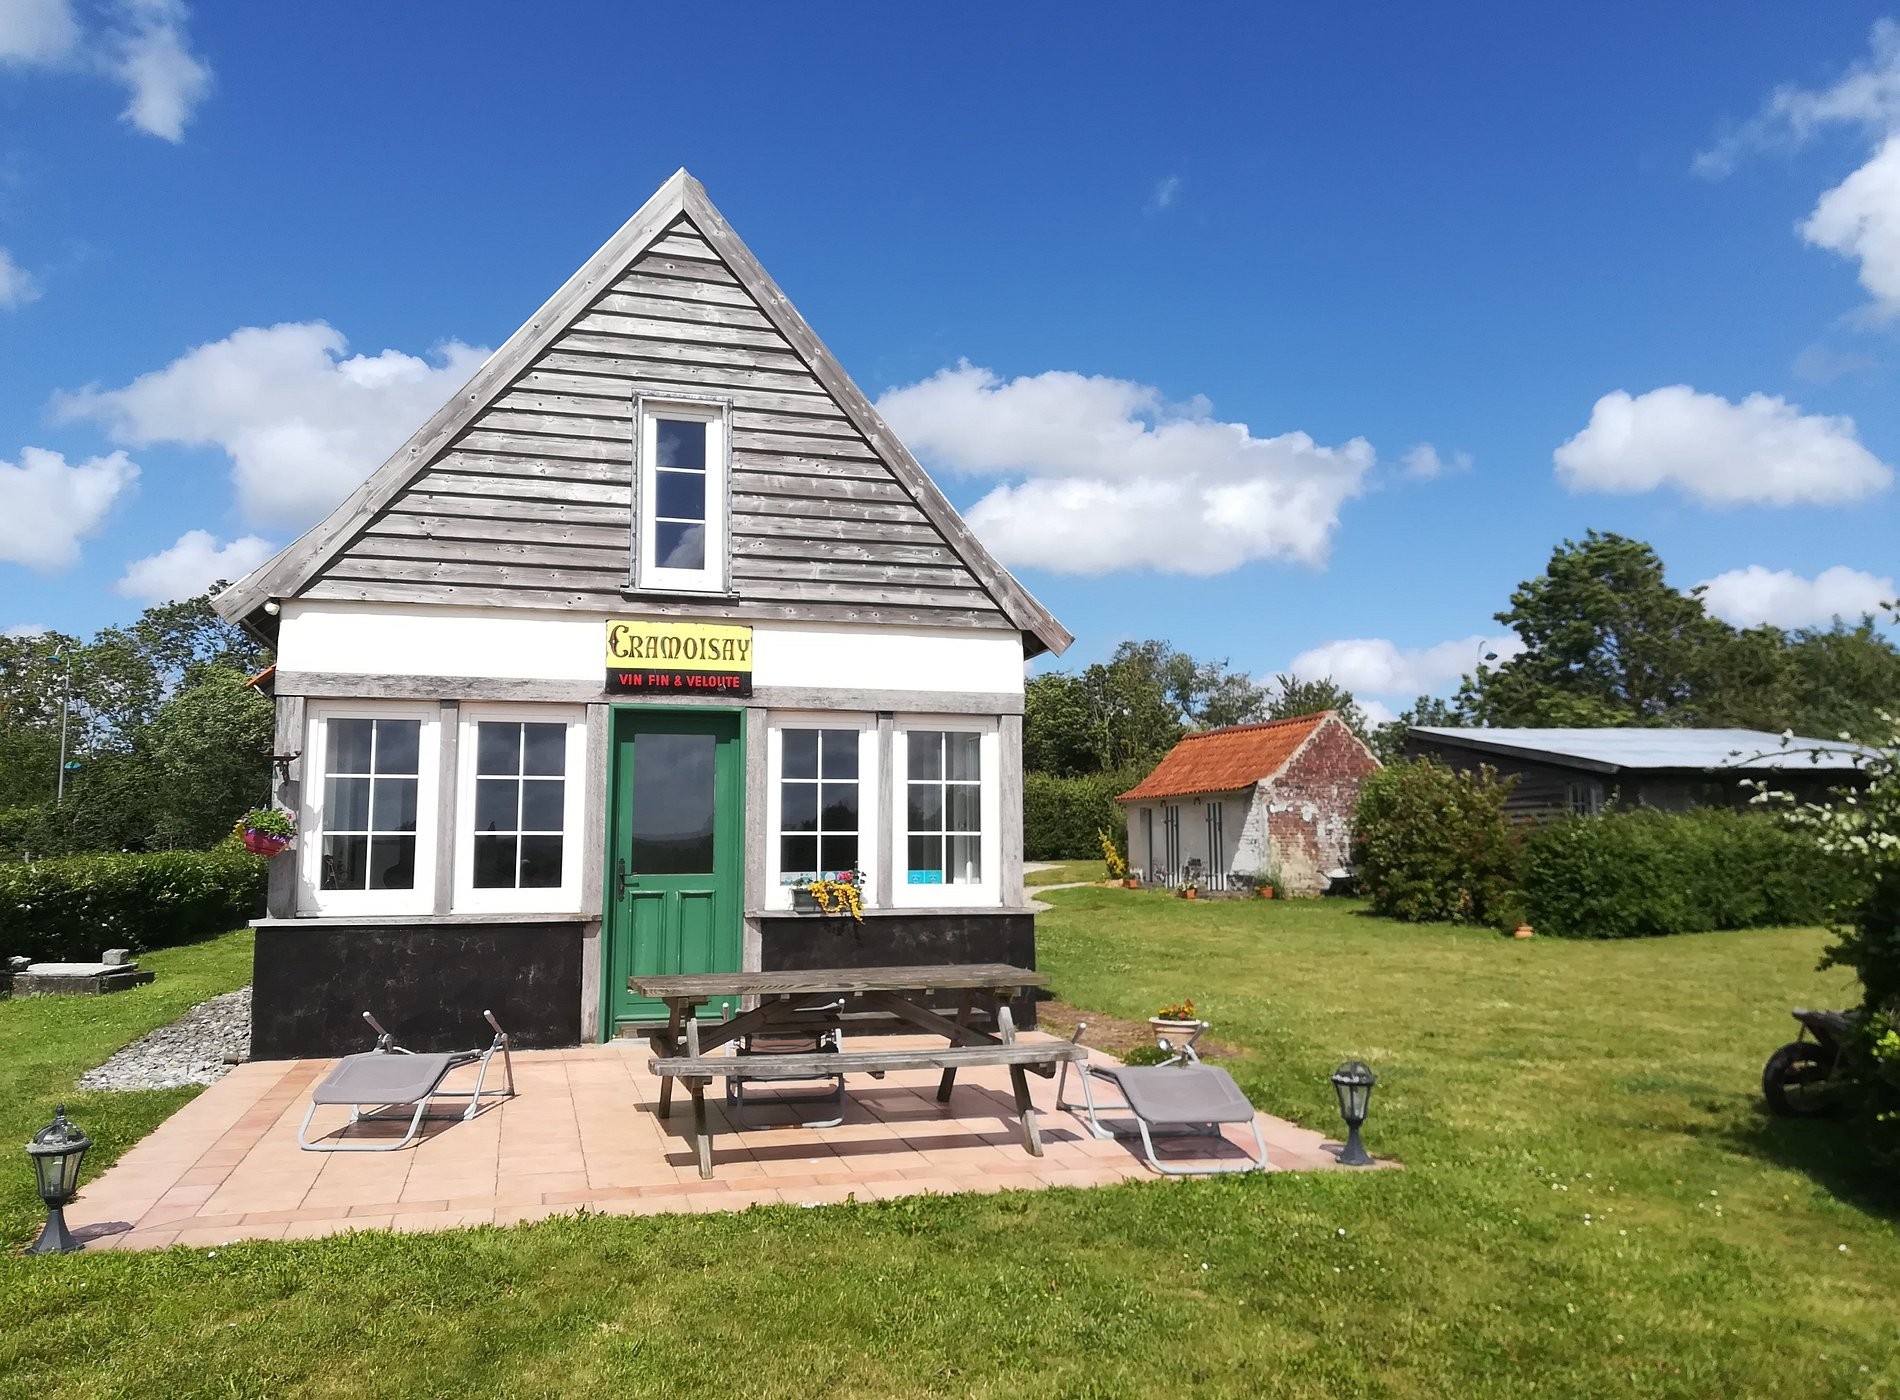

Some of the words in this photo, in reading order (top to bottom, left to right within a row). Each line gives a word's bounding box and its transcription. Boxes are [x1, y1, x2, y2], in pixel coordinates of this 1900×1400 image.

[608, 625, 750, 661] CRAMOISAY
[619, 674, 642, 686] VIN
[649, 674, 669, 686] FIN
[674, 675, 682, 687] &
